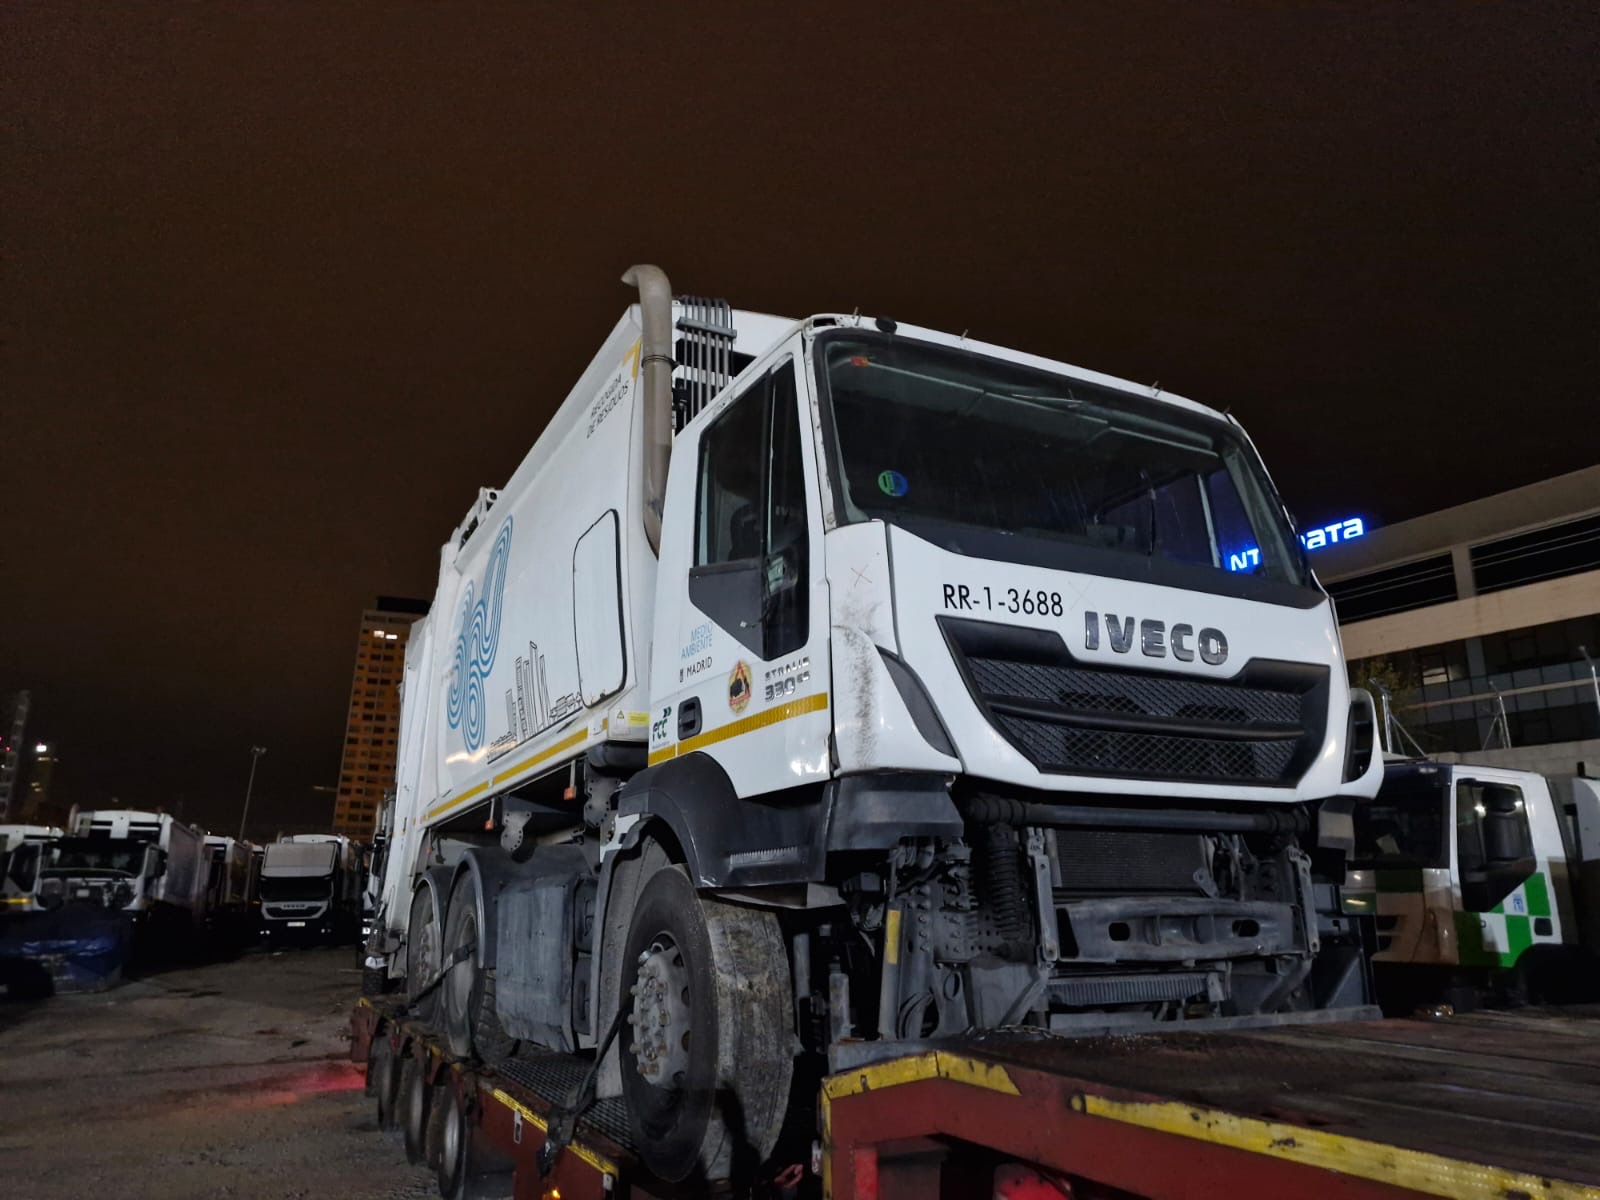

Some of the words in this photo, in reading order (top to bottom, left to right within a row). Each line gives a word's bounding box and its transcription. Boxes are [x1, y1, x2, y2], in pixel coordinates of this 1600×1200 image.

[1230, 548, 1260, 571] NT
[943, 583, 1064, 616] RR-1-3688
[691, 621, 714, 641] MEDIO
[1084, 611, 1229, 666] IVECO
[681, 634, 713, 660] AMBIENTE
[686, 656, 713, 678] MADRID
[764, 656, 810, 681] STRALIS
[764, 676, 796, 702] 330
